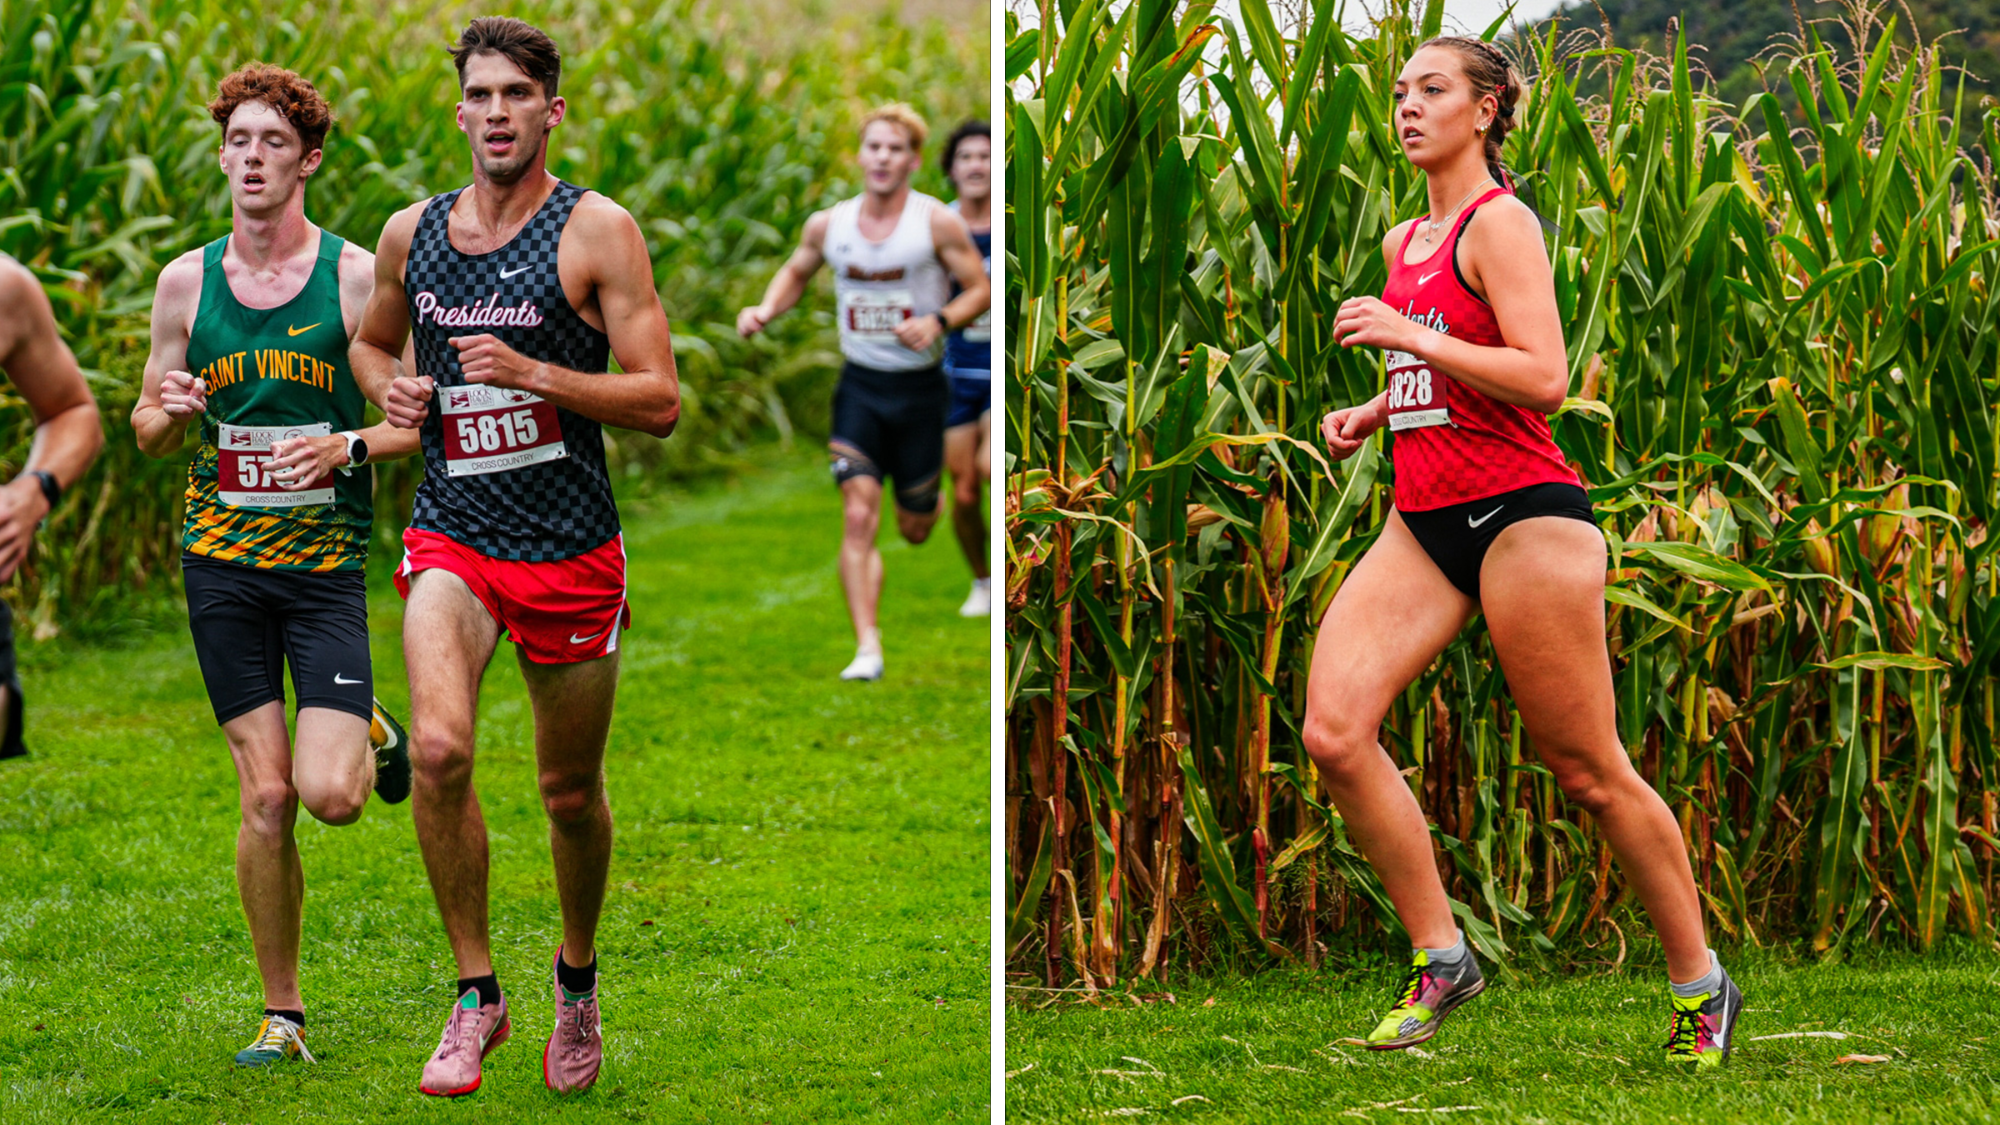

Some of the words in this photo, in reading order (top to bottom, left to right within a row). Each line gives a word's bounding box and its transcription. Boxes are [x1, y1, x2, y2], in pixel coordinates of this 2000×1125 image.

[415, 291, 543, 327] Presidents
[200, 351, 247, 396] SAINT
[254, 349, 336, 393] VINCENT
[457, 409, 539, 454] 5815
[471, 460, 497, 470] CROSS
[497, 452, 535, 467] COUNTRY
[245, 495, 271, 503] CROSS
[271, 494, 306, 503] COUNTRY
